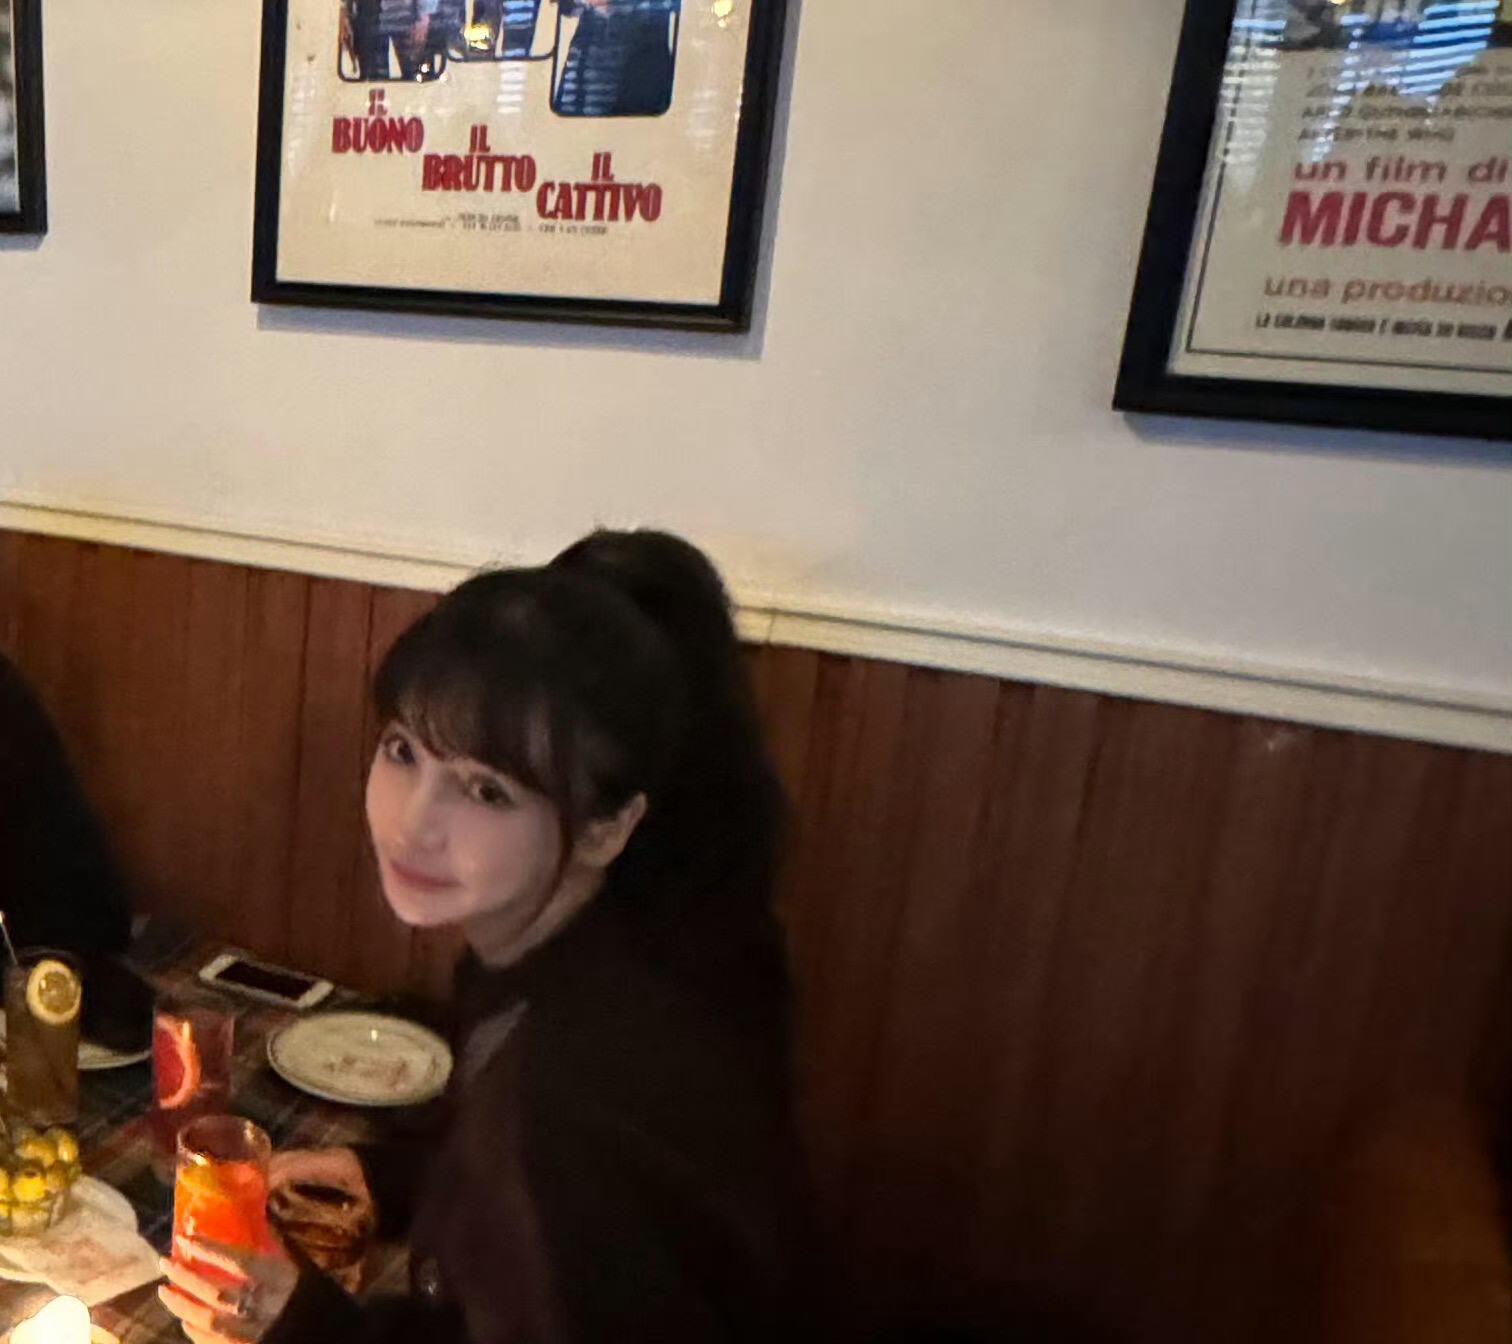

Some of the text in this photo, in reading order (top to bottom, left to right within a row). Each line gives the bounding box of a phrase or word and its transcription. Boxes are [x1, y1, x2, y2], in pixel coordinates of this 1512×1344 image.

[368, 88, 387, 117] IL
[331, 116, 425, 154] BUONO
[469, 124, 491, 153] IL
[422, 154, 536, 192] BRUTTO
[591, 151, 614, 182] IL
[1295, 156, 1508, 184] un film di
[537, 181, 662, 223] CATTIVO
[1278, 191, 1510, 252] MICHA
[1264, 275, 1331, 299] una
